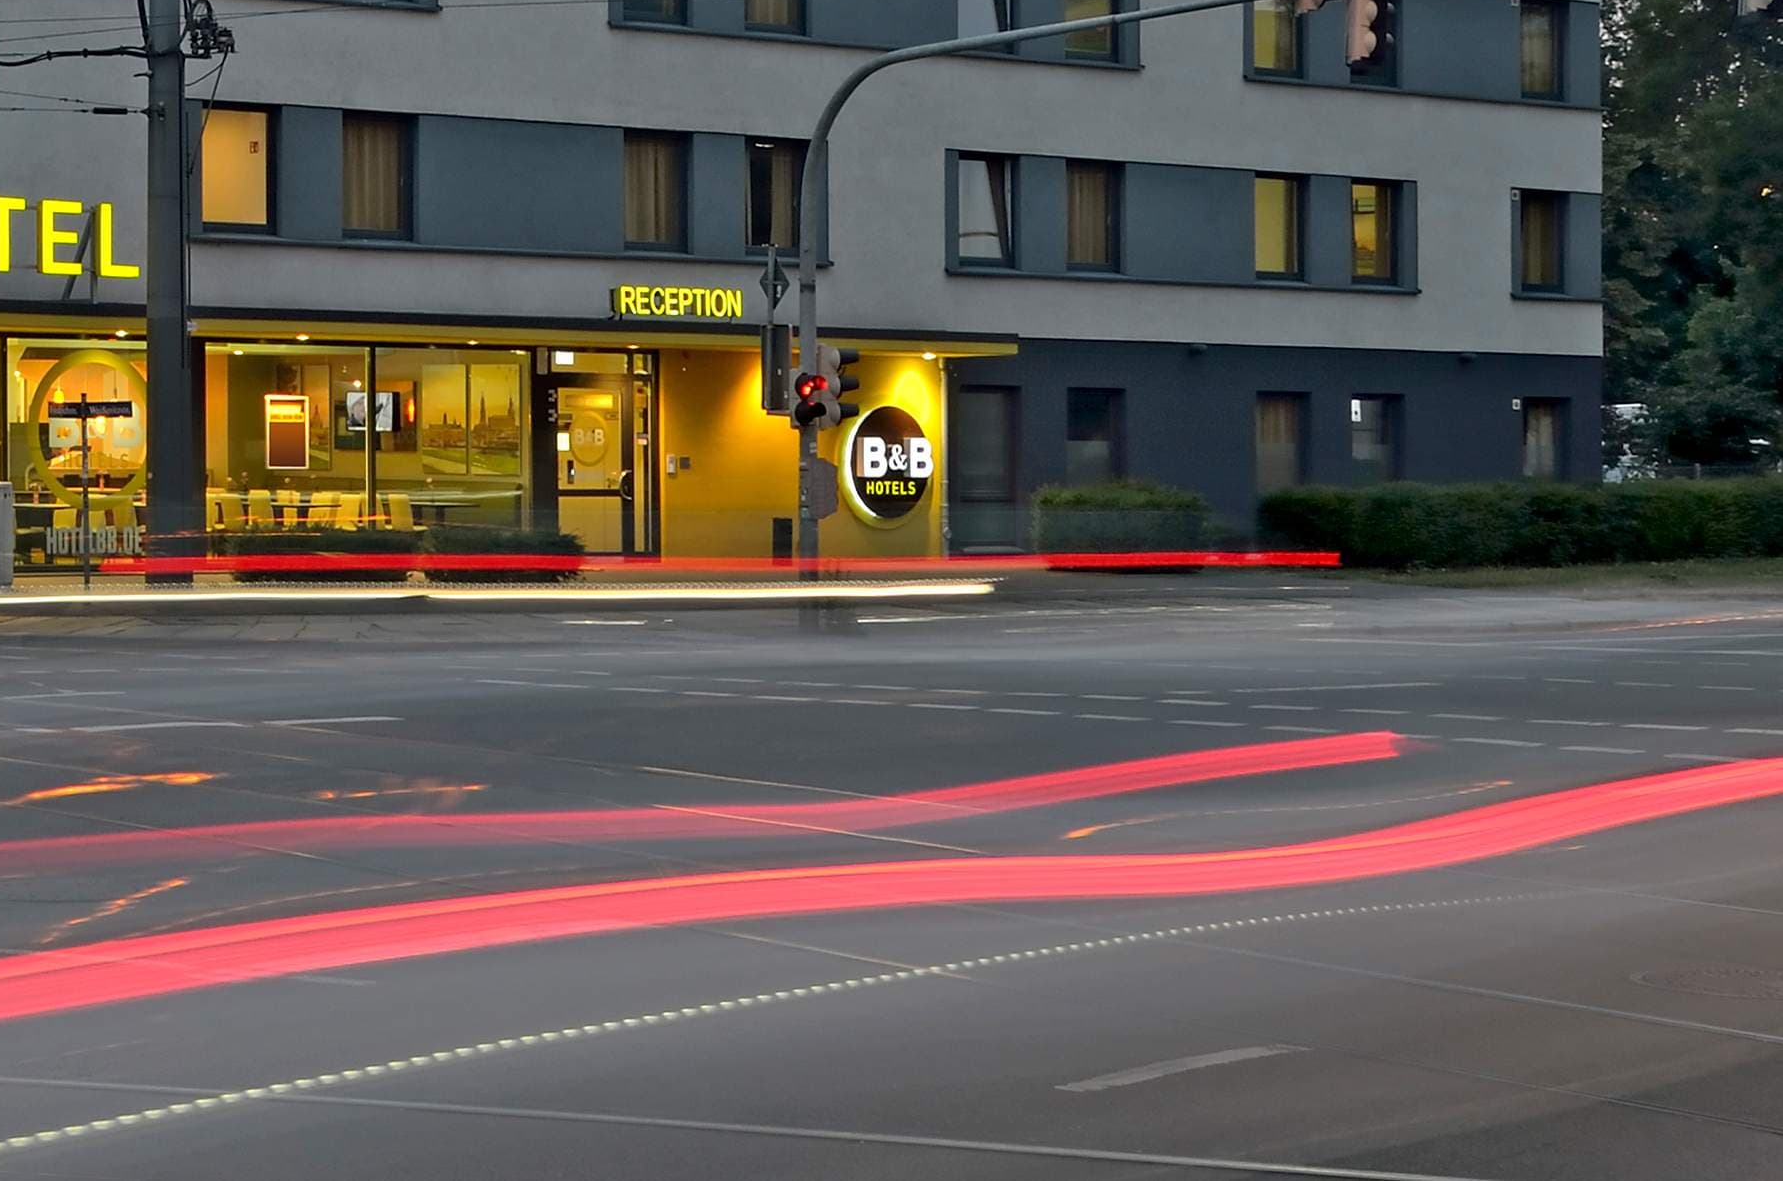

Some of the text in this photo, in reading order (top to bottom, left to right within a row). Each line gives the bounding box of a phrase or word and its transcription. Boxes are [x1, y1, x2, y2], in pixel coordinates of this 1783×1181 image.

[619, 285, 742, 317] RECEPTION
[857, 436, 933, 478] B&B
[866, 480, 917, 495] HOTELS
